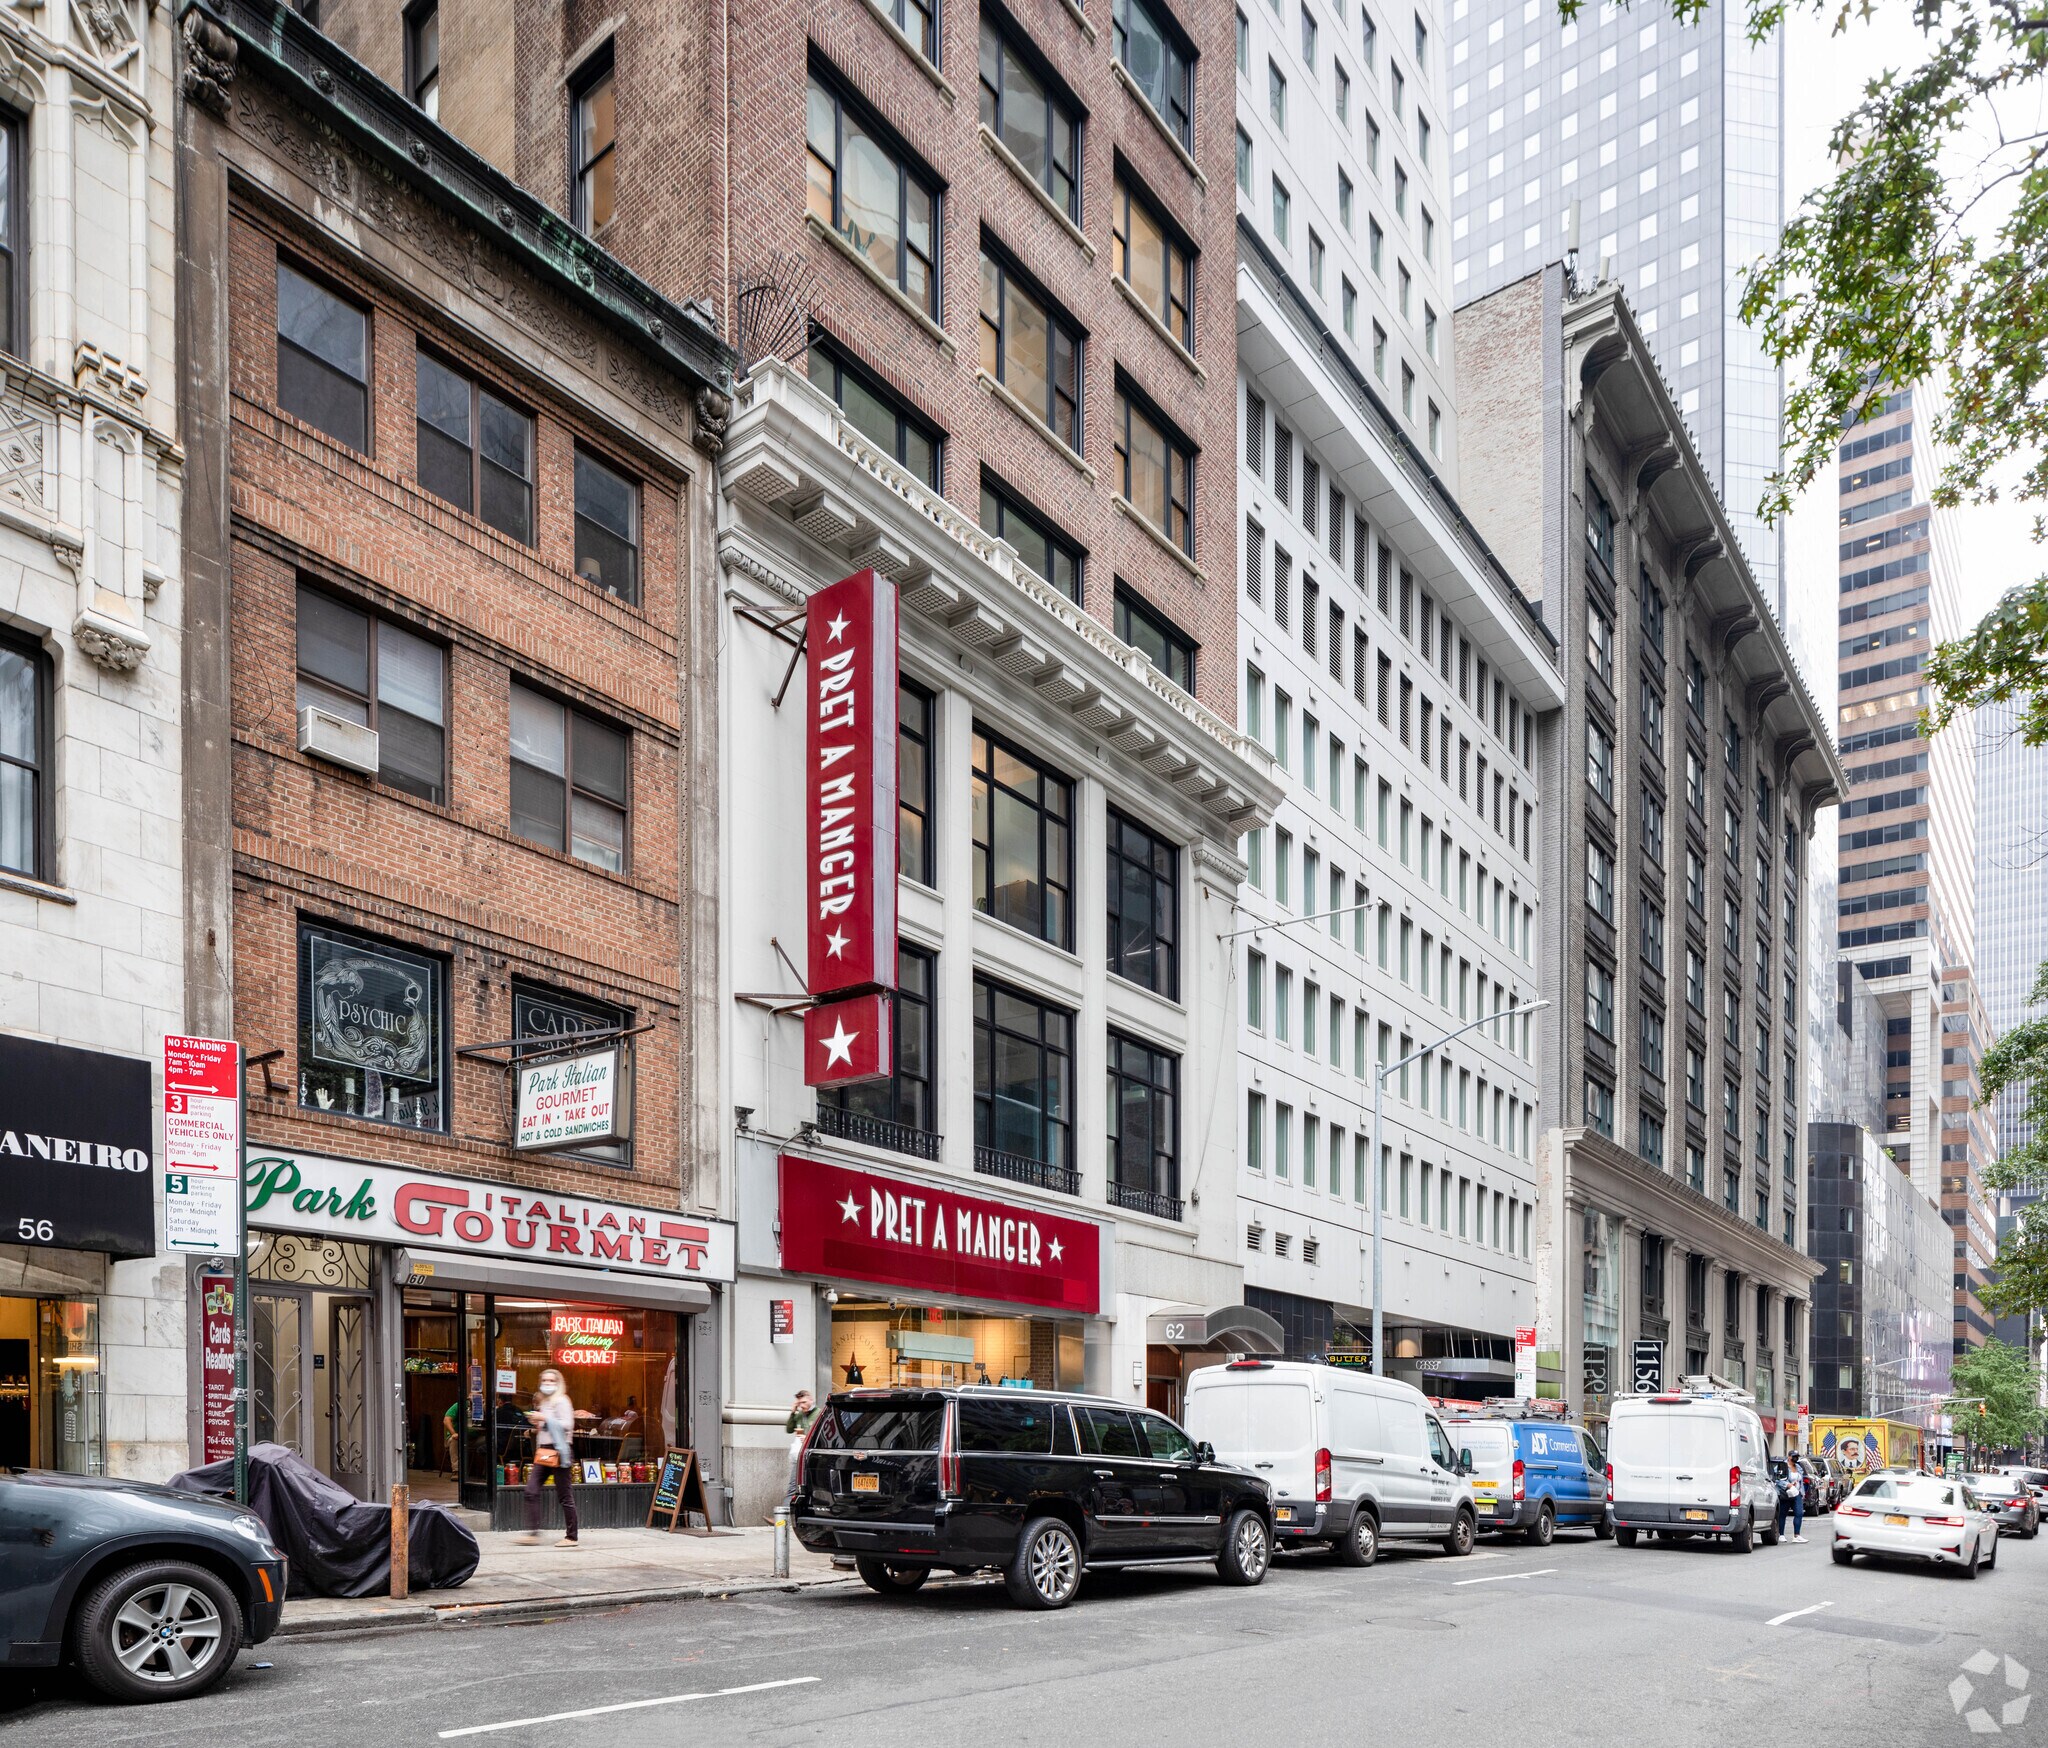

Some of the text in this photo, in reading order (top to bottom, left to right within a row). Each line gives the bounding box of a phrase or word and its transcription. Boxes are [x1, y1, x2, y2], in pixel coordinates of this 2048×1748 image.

[820, 646, 855, 921] PRET A MANGER
[338, 1000, 406, 1035] PSYCHIC
[168, 1038, 227, 1052] NO STANDING
[168, 1050, 194, 1060] Monday
[200, 1054, 222, 1064] Friday
[188, 1060, 206, 1068] 10am
[168, 1066, 183, 1074] 4pm
[528, 1061, 607, 1095] Park Italian
[170, 1096, 182, 1112] 3
[536, 1086, 597, 1111] GOURMET
[168, 1118, 224, 1130] COMMERCIAL
[522, 1103, 610, 1128] EAT IN TAKE OUT
[169, 1128, 234, 1140] VEHICLES ONLY
[520, 1120, 609, 1142] HOT & COLD SANDWICHES
[0, 1129, 149, 1173] ANEIRO
[168, 1140, 194, 1148] Monday
[201, 1142, 222, 1151] Friday
[171, 1176, 184, 1192] 5
[246, 1156, 378, 1221] Park
[190, 1208, 217, 1216] Midnight
[202, 1201, 222, 1209] Friday
[485, 1193, 646, 1234] ITALIAN
[18, 1217, 54, 1242] 56
[169, 1218, 200, 1226] Saturday
[190, 1227, 217, 1235] Midnight
[393, 1182, 709, 1271] GOURMET
[870, 1185, 1042, 1267] PRET A MANGER
[410, 1274, 426, 1284] 60
[210, 1321, 230, 1344] Cards
[555, 1317, 623, 1335] PARK ITALIAN
[1166, 1323, 1184, 1340] 62
[568, 1332, 614, 1350] Catering
[206, 1347, 234, 1374] Readings
[563, 1350, 618, 1364] GOURMET
[1635, 1344, 1660, 1392] 1156
[1532, 1432, 1578, 1455] ADT Commercial
[587, 1463, 597, 1479] A
